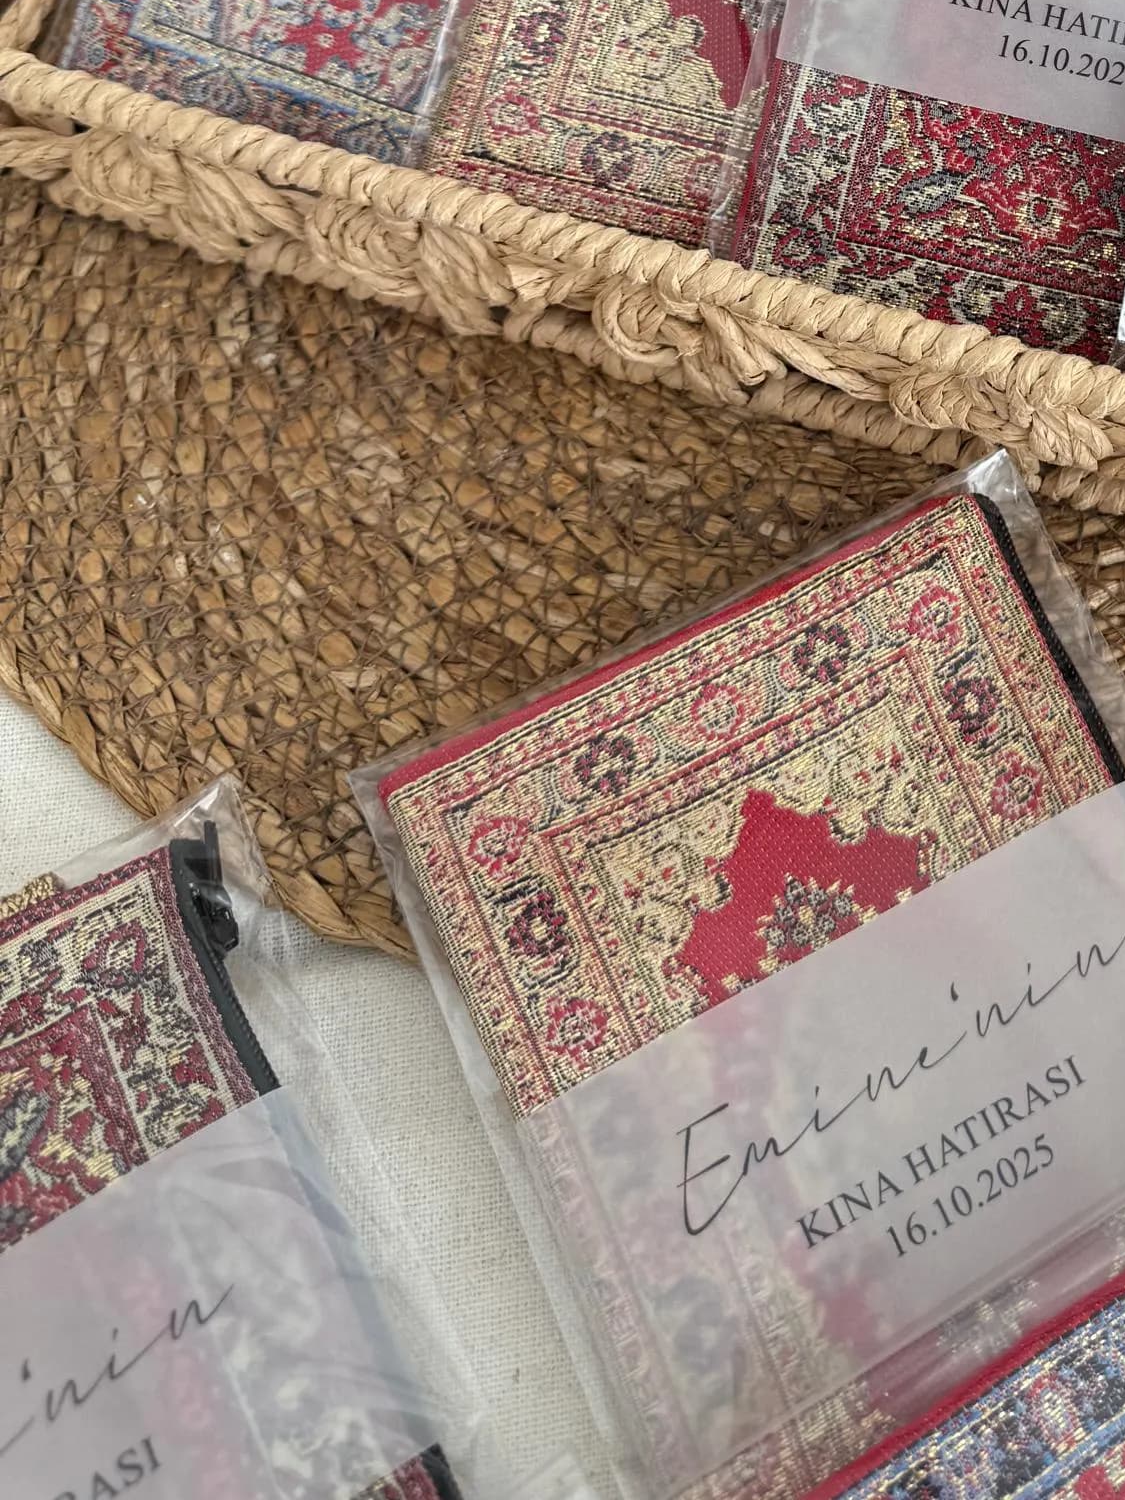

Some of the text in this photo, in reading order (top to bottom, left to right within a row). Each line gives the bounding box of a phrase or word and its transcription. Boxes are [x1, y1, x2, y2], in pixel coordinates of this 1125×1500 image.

[795, 1055, 1087, 1249] KINA HATIRASI
[885, 1133, 1055, 1258] 16.10.2025
[52, 1436, 161, 1500] ASI
